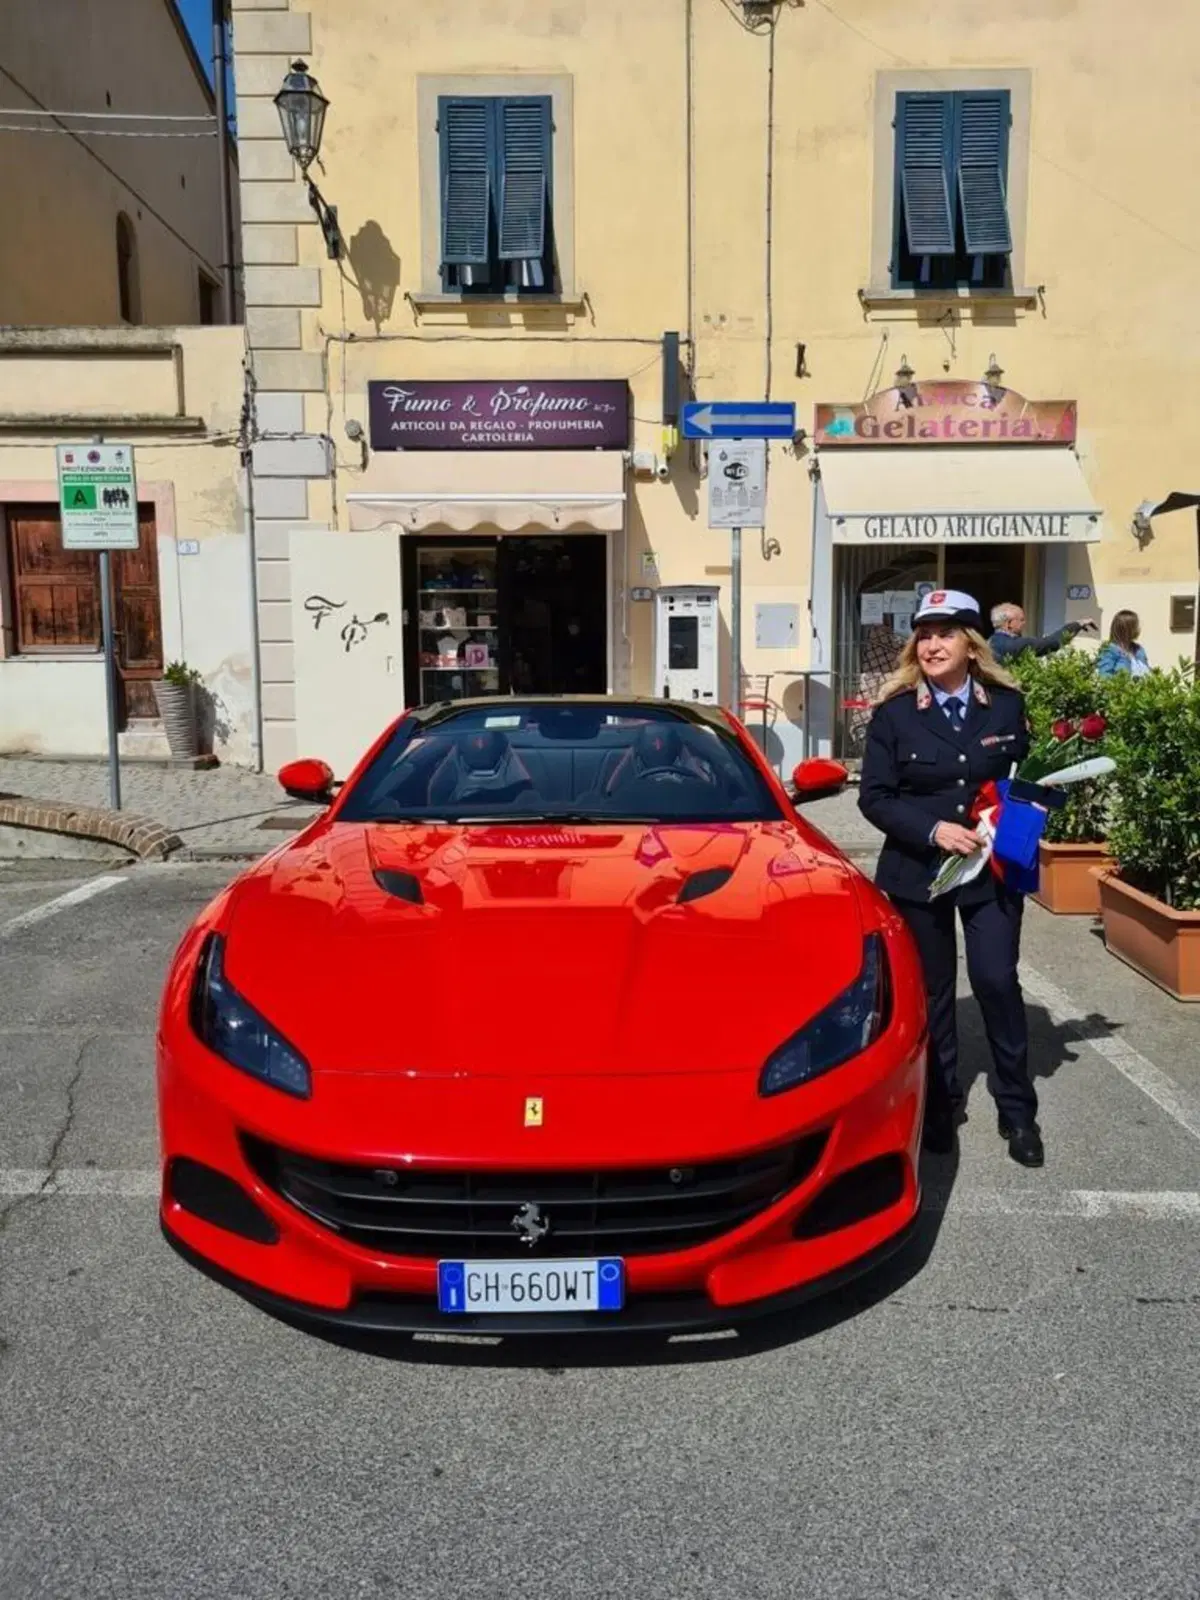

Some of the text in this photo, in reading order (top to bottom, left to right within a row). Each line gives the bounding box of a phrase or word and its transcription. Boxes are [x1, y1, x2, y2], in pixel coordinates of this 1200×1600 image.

[382, 386, 453, 413] Fumo
[462, 394, 482, 417] &
[488, 385, 591, 417] Profumo
[390, 420, 446, 431] ARTICOLI
[449, 420, 467, 431] DA
[470, 420, 517, 431] REGALO
[528, 419, 605, 431] PROFUMERIA
[854, 411, 1032, 439] Gelateria
[461, 432, 535, 443] CARTOLERIA
[73, 489, 88, 505] A
[864, 514, 1070, 538] GELATO ARTIGIANALE
[466, 1271, 501, 1302] GH
